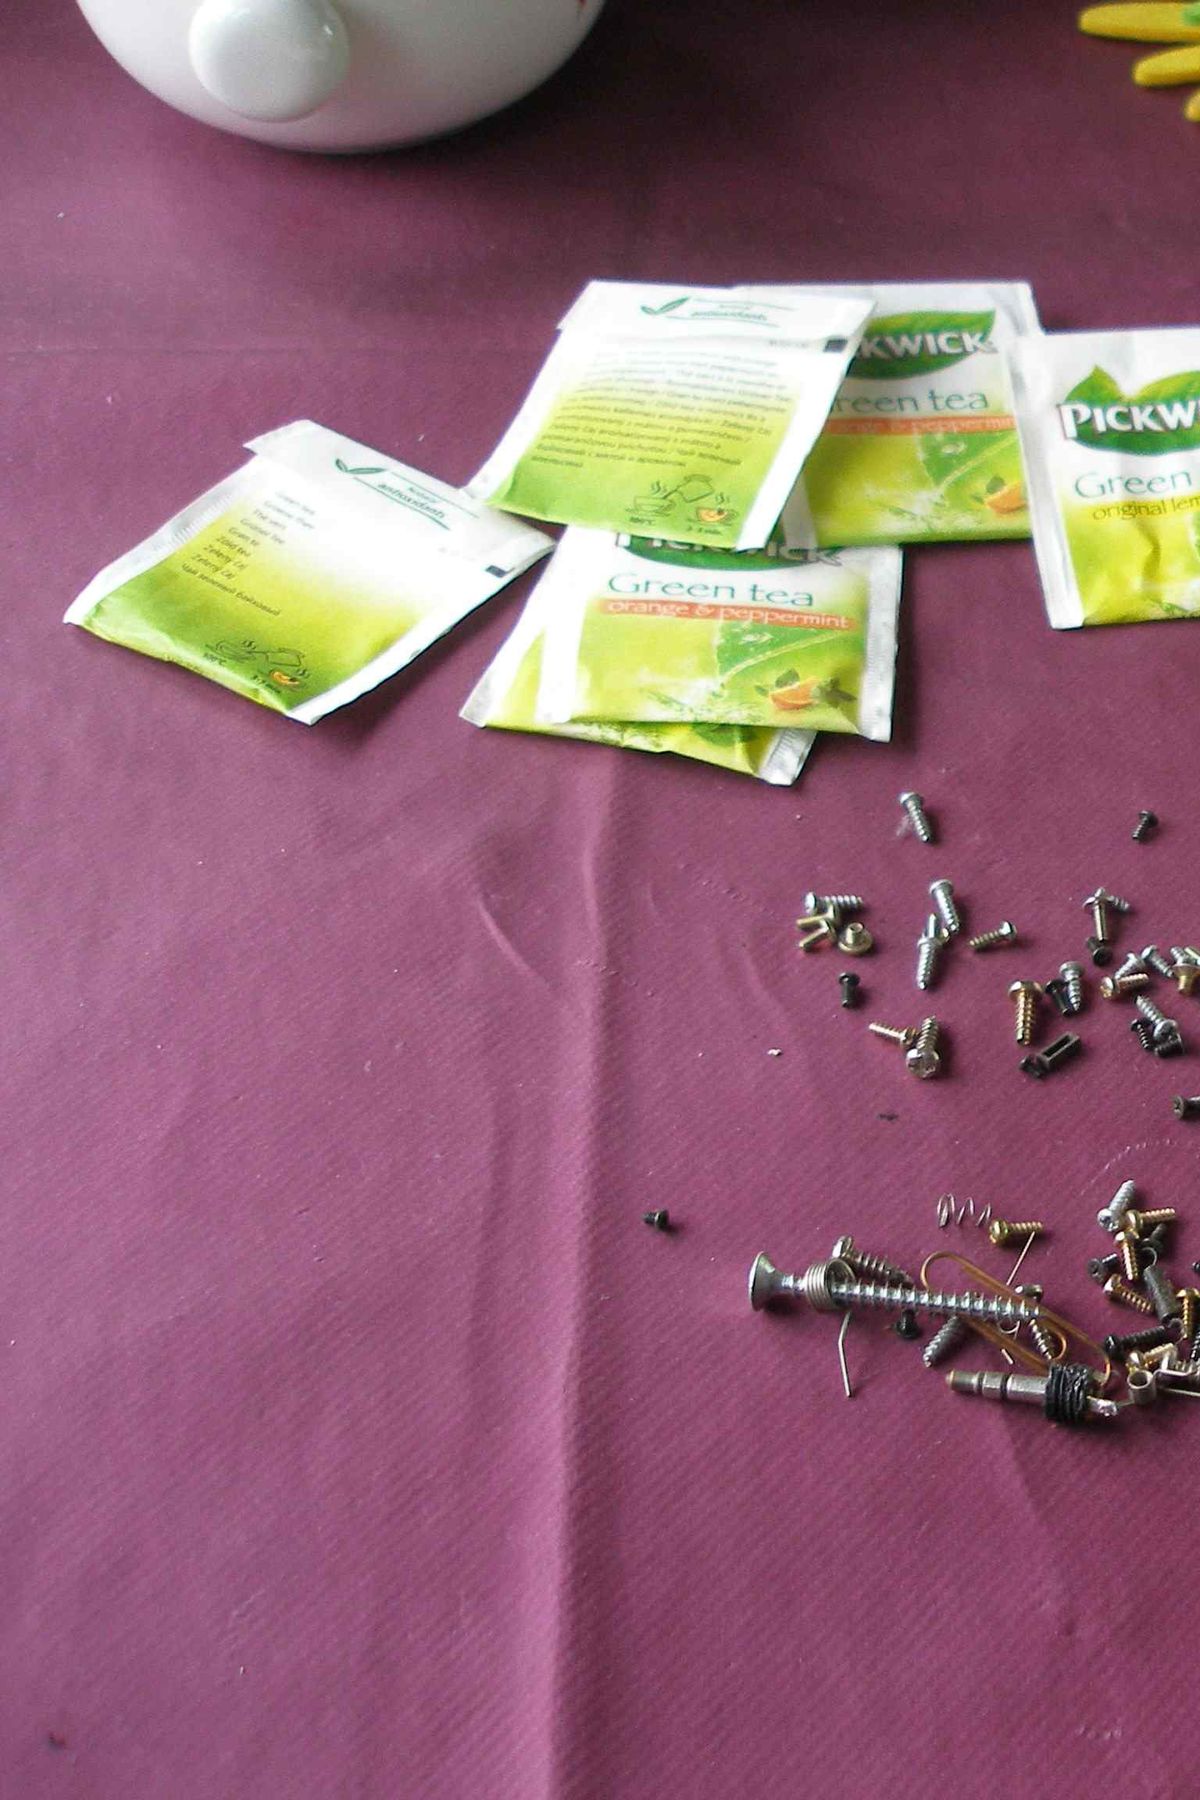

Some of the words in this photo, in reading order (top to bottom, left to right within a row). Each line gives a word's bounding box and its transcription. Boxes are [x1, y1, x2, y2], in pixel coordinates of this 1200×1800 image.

[860, 331, 998, 359] KWICK
[836, 396, 919, 413] reen
[928, 389, 989, 411] tea
[1075, 470, 1191, 499] Green
[1093, 500, 1166, 521] original
[608, 573, 735, 599] Green
[752, 583, 814, 607] tea
[608, 600, 690, 616] orange
[695, 605, 712, 617] &
[720, 607, 849, 629] peppermint
